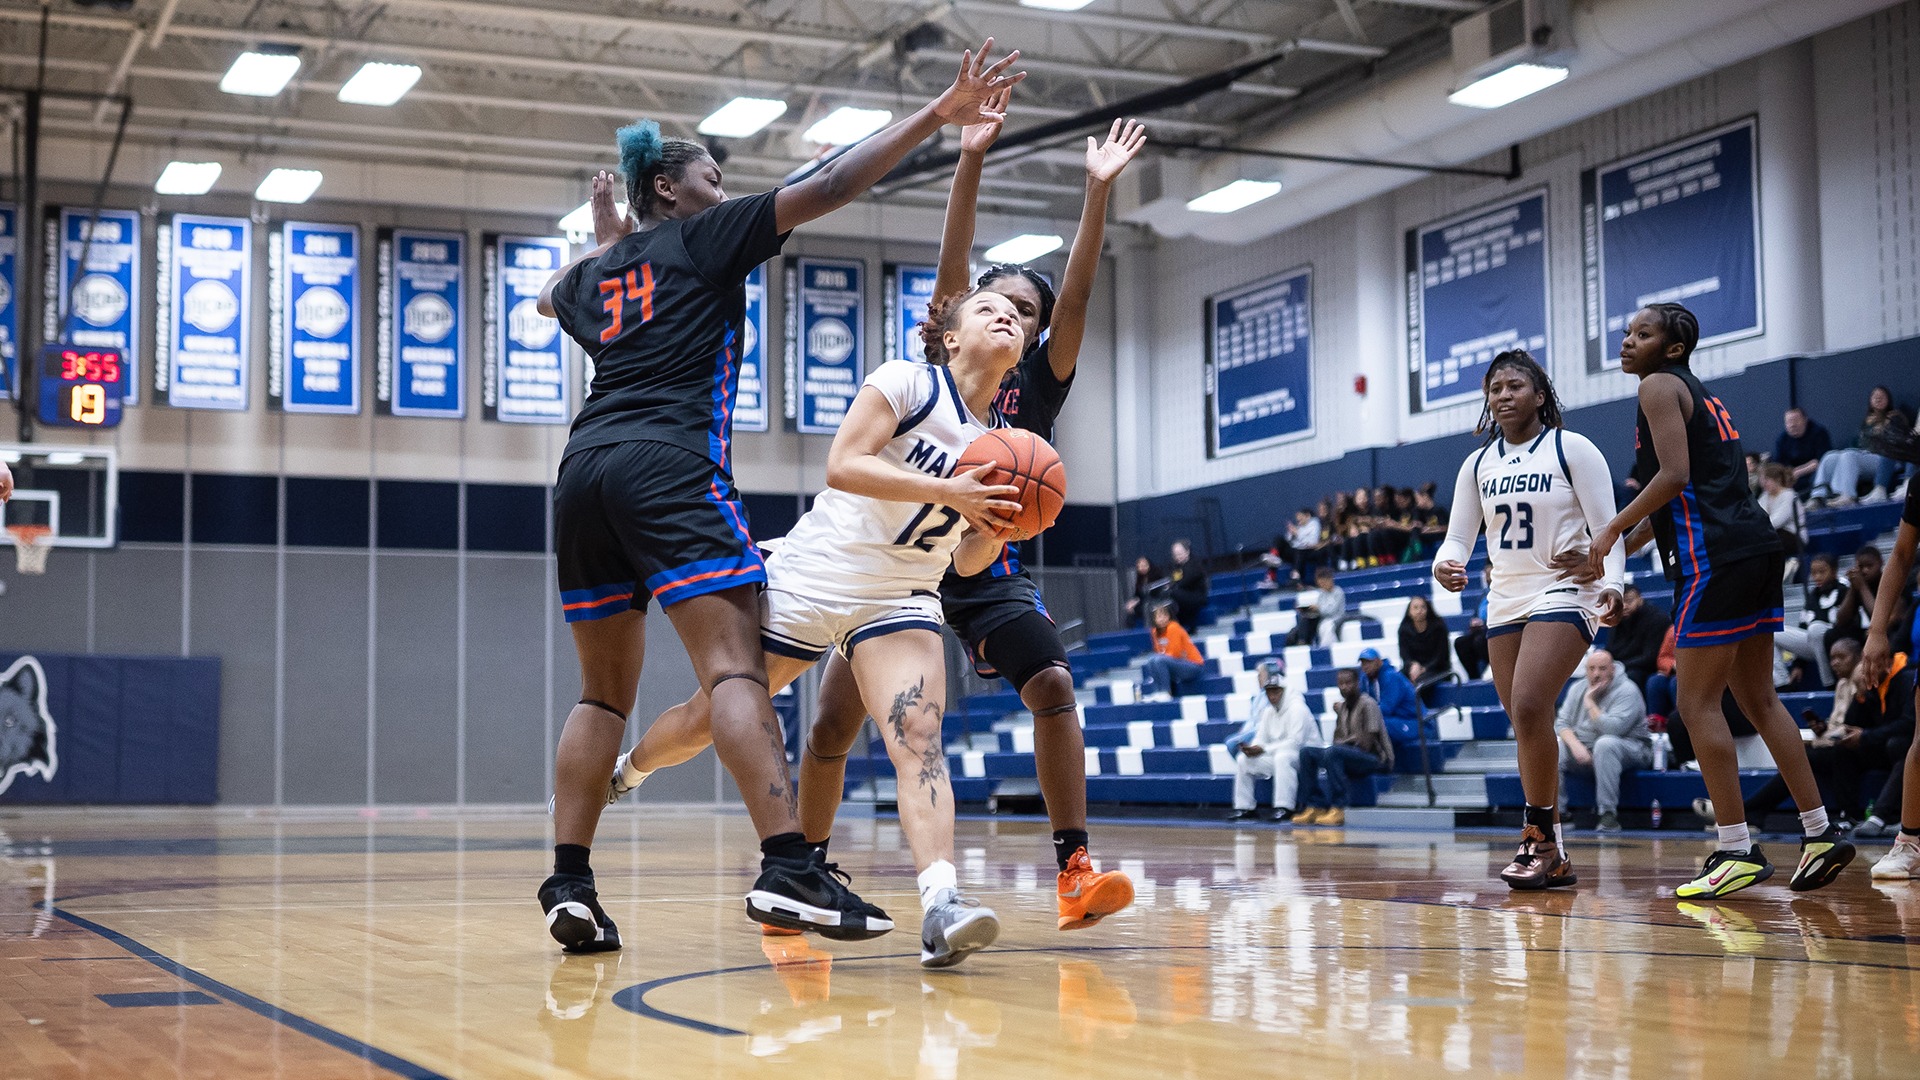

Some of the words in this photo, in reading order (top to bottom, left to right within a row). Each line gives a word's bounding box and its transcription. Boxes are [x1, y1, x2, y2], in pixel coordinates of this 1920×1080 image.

[598, 261, 656, 343] 34
[61, 350, 119, 382] 3:55
[70, 384, 105, 424] 19
[1703, 395, 1740, 442] 12
[1482, 473, 1553, 500] MADISON
[893, 502, 962, 554] 12
[1494, 501, 1534, 550] 23
